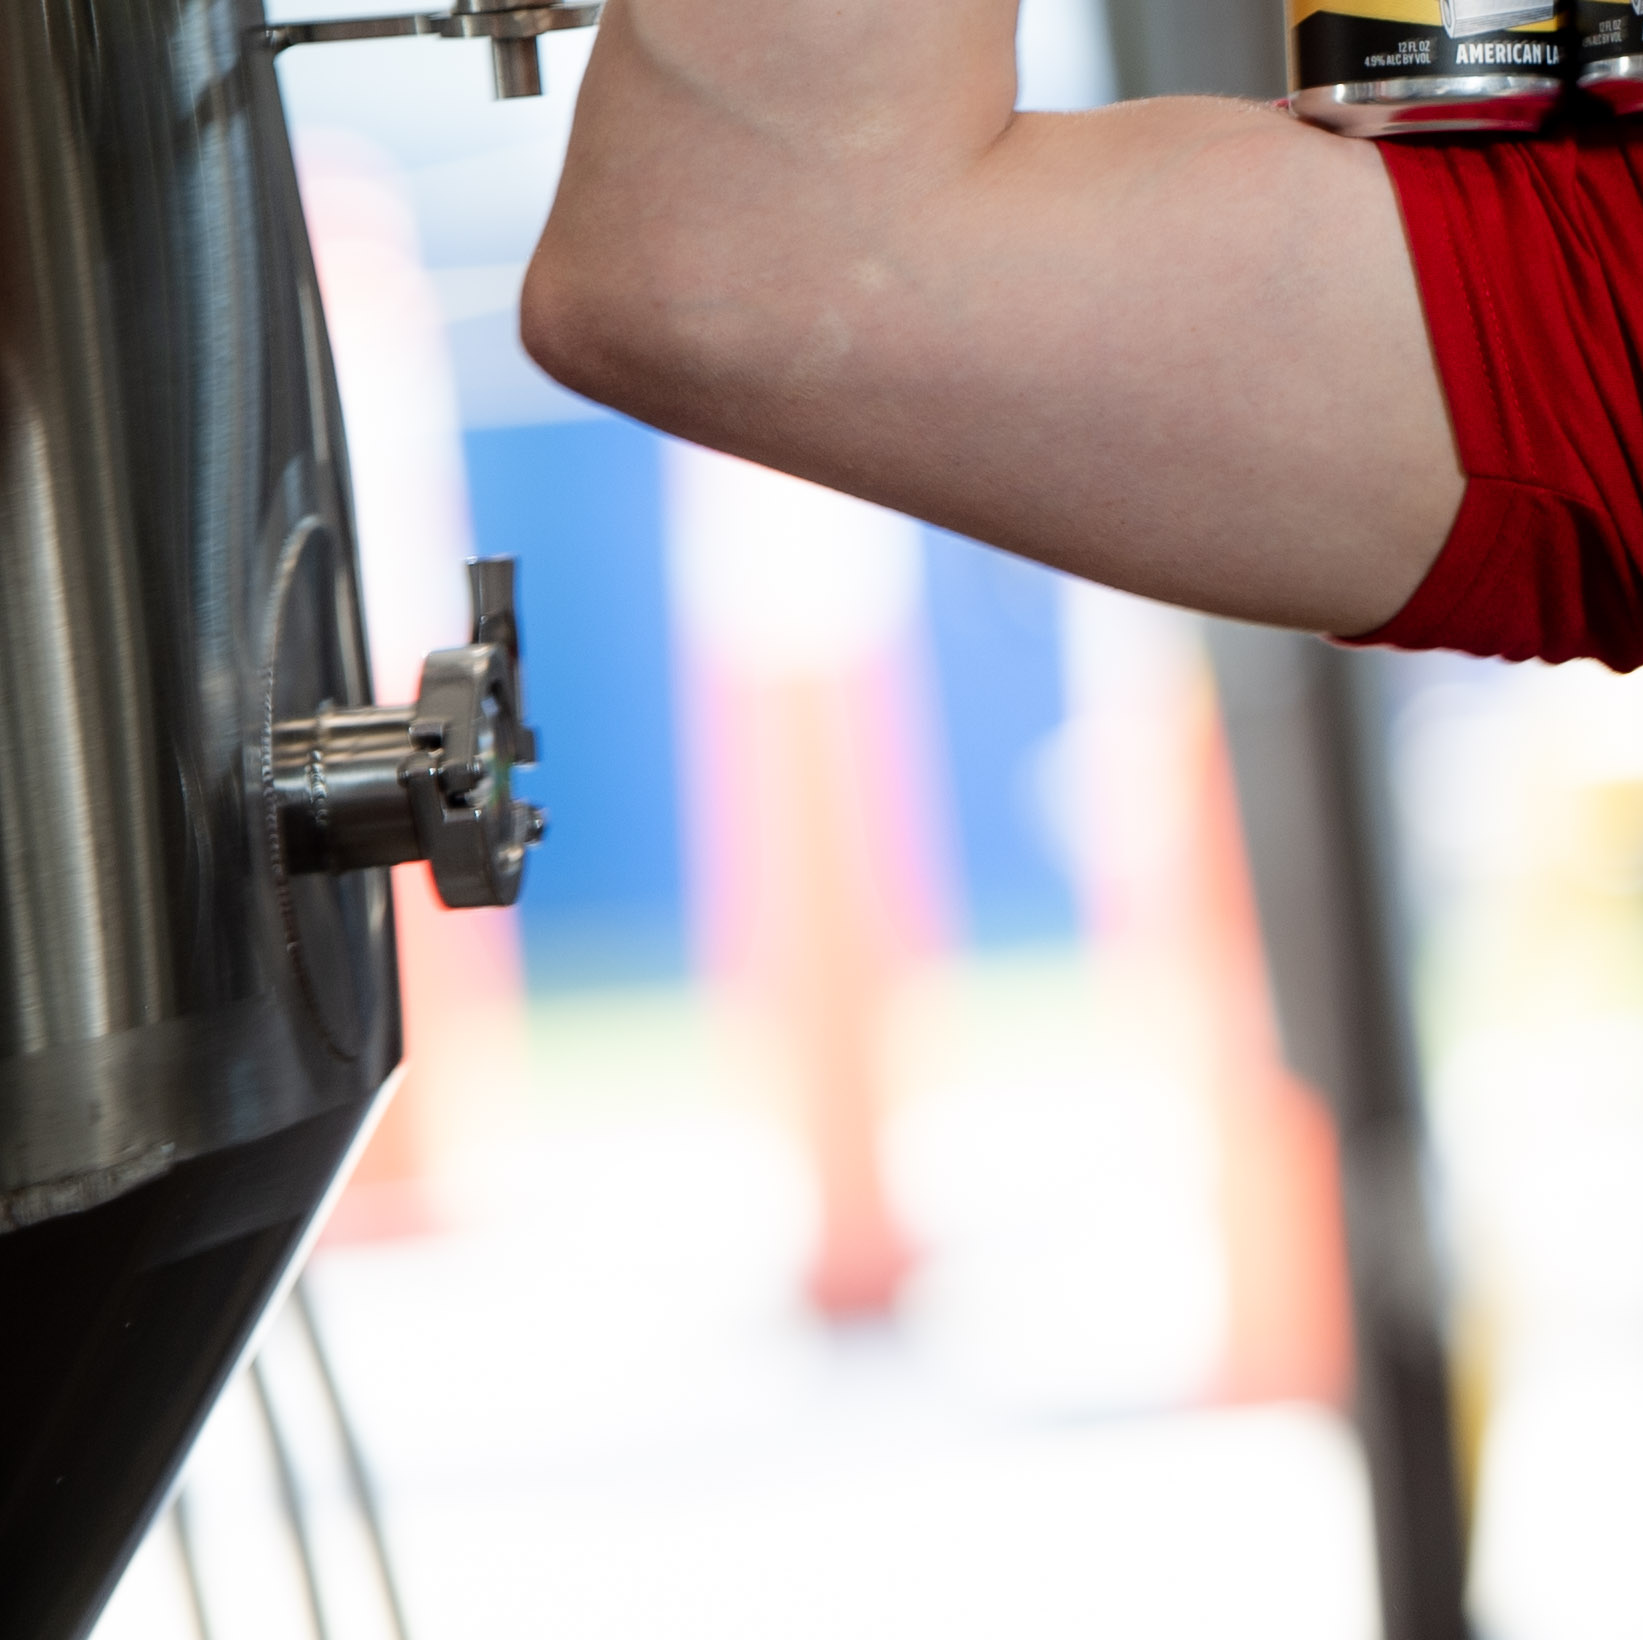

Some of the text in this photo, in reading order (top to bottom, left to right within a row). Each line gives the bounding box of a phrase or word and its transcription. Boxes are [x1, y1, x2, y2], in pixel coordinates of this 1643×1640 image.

[1398, 41, 1431, 52] 12 FL OZ
[1386, 55, 1401, 66] ALC
[1402, 54, 1414, 65] BY
[1414, 53, 1431, 64] VOL
[1455, 44, 1541, 65] AMERICAN
